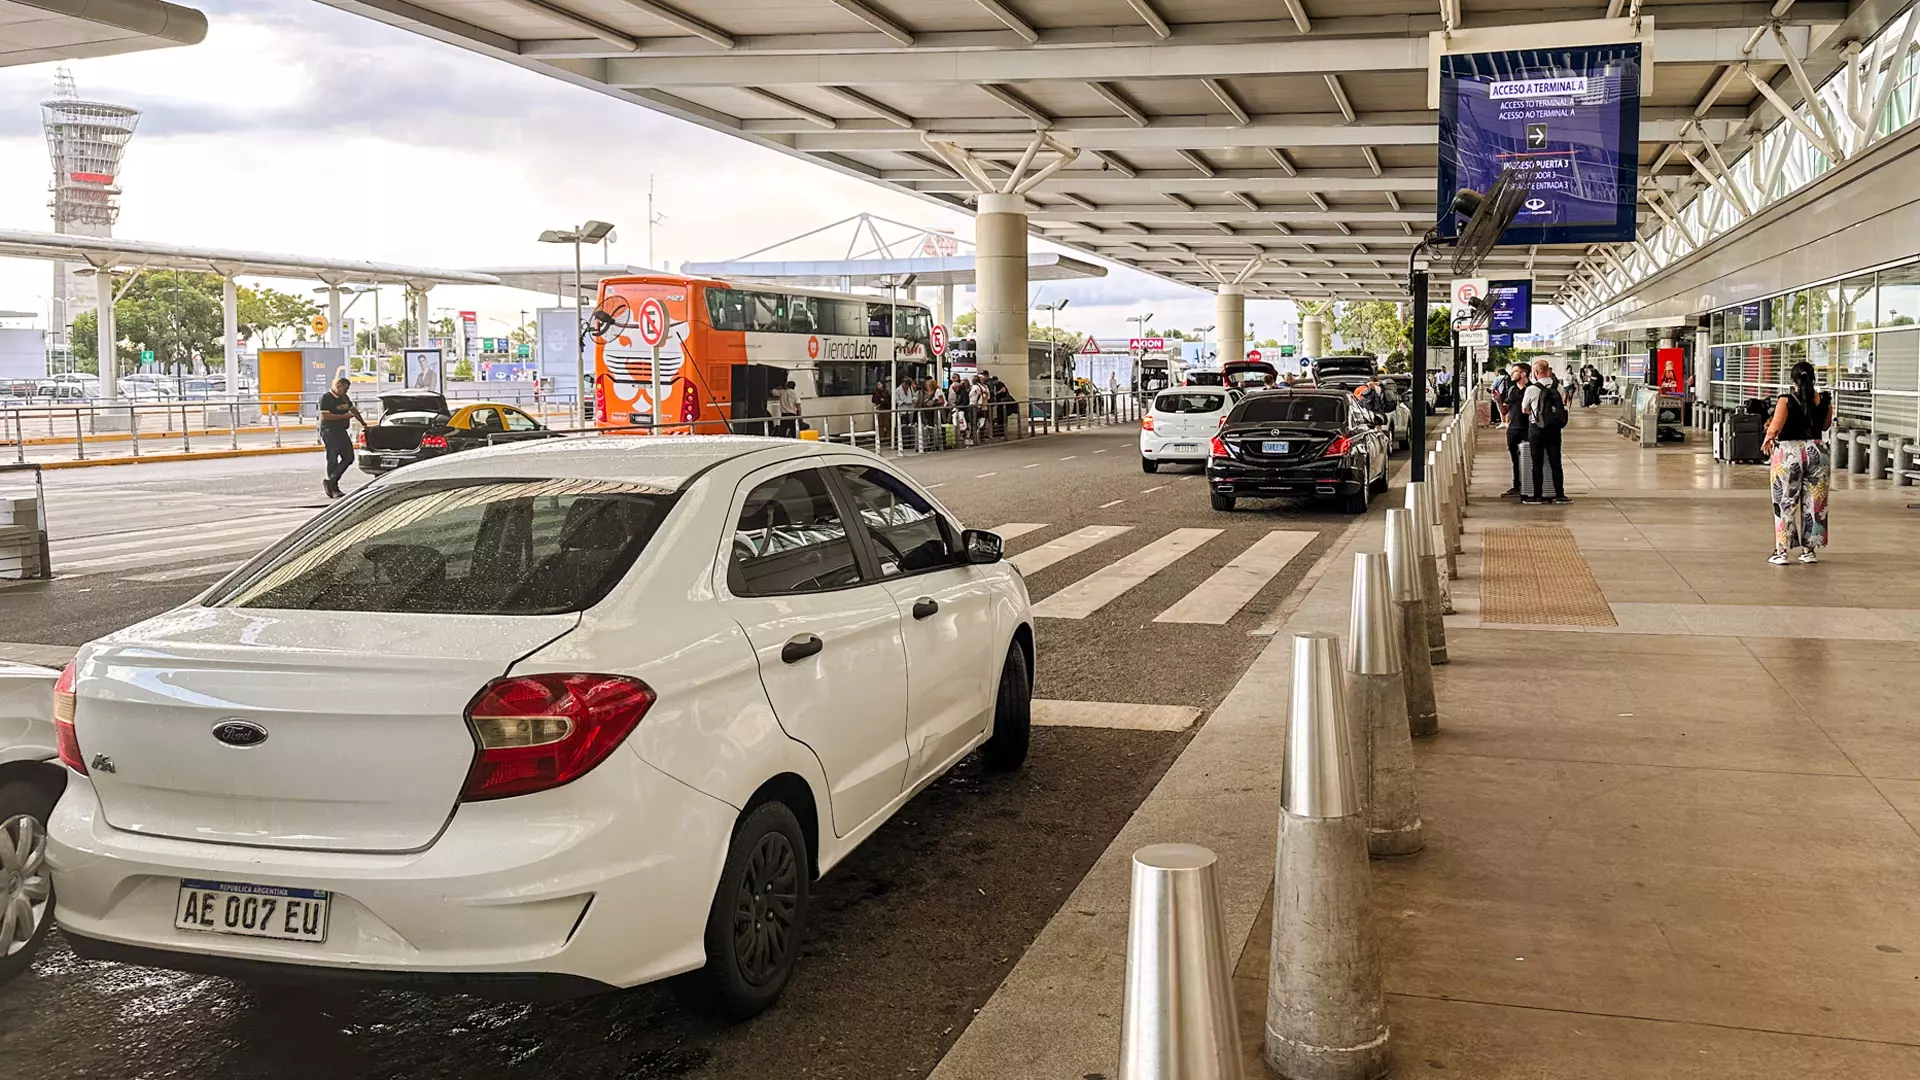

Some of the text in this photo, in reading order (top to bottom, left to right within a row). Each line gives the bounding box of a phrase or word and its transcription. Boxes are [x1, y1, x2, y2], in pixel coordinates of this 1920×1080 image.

[1493, 80, 1584, 96] ACCESO A TERMINAL A
[1500, 98, 1575, 109] ACCESS TO TERMINAL A
[1499, 108, 1575, 120] ACESSO AO TERMINAL A
[1536, 159, 1563, 169] PUERTA
[1563, 159, 1569, 168] 3
[1552, 171, 1557, 179] 3
[1536, 181, 1563, 190] ENTRADA
[1564, 181, 1569, 189] 3
[1131, 340, 1162, 349] AXION
[222, 726, 252, 741] Ford
[252, 885, 288, 896] ARGENTINA
[183, 891, 320, 935] AE 007 EU
